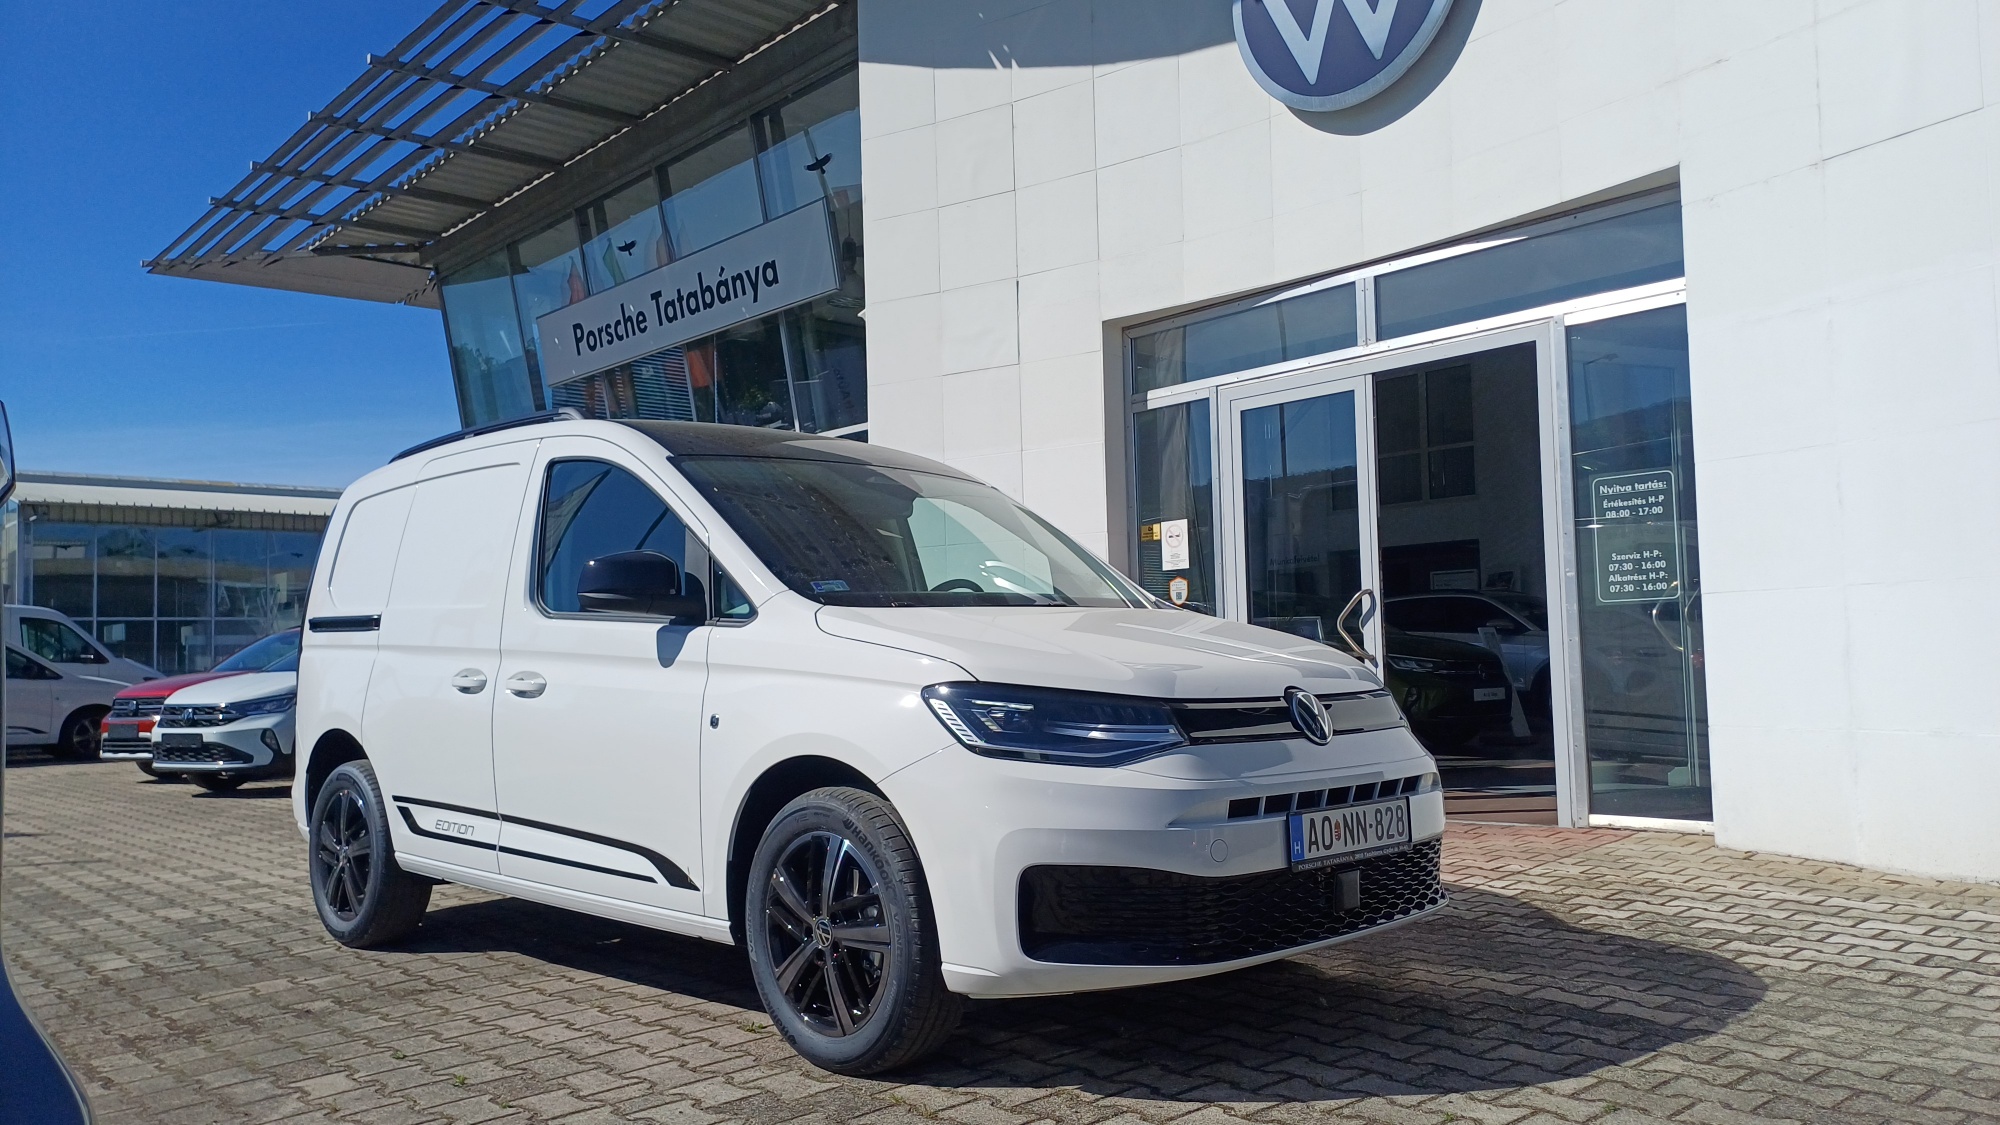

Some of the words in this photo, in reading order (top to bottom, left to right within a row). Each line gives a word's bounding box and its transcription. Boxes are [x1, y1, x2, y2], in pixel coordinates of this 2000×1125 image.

[572, 303, 648, 356] Porsche
[650, 258, 779, 328] Tatabánya
[1600, 485, 1632, 495] Nyitva
[1635, 480, 1667, 491] tartás:
[1603, 498, 1646, 508] Értékesítés
[1648, 495, 1664, 504] H-P
[1605, 509, 1630, 518] 08:00
[1638, 506, 1663, 516] 17:00
[1611, 552, 1641, 560] Szerviz
[1643, 550, 1662, 559] H-P:
[1608, 562, 1633, 572] 07:30
[1641, 560, 1666, 570] 16:00
[1608, 573, 1647, 582] Alkatrész
[1649, 571, 1668, 580] H-P:
[1609, 584, 1634, 593] 07:30
[1642, 582, 1667, 592] 16:00
[435, 819, 475, 836] EDITION
[1294, 841, 1301, 855] H
[851, 825, 897, 892] Hankook
